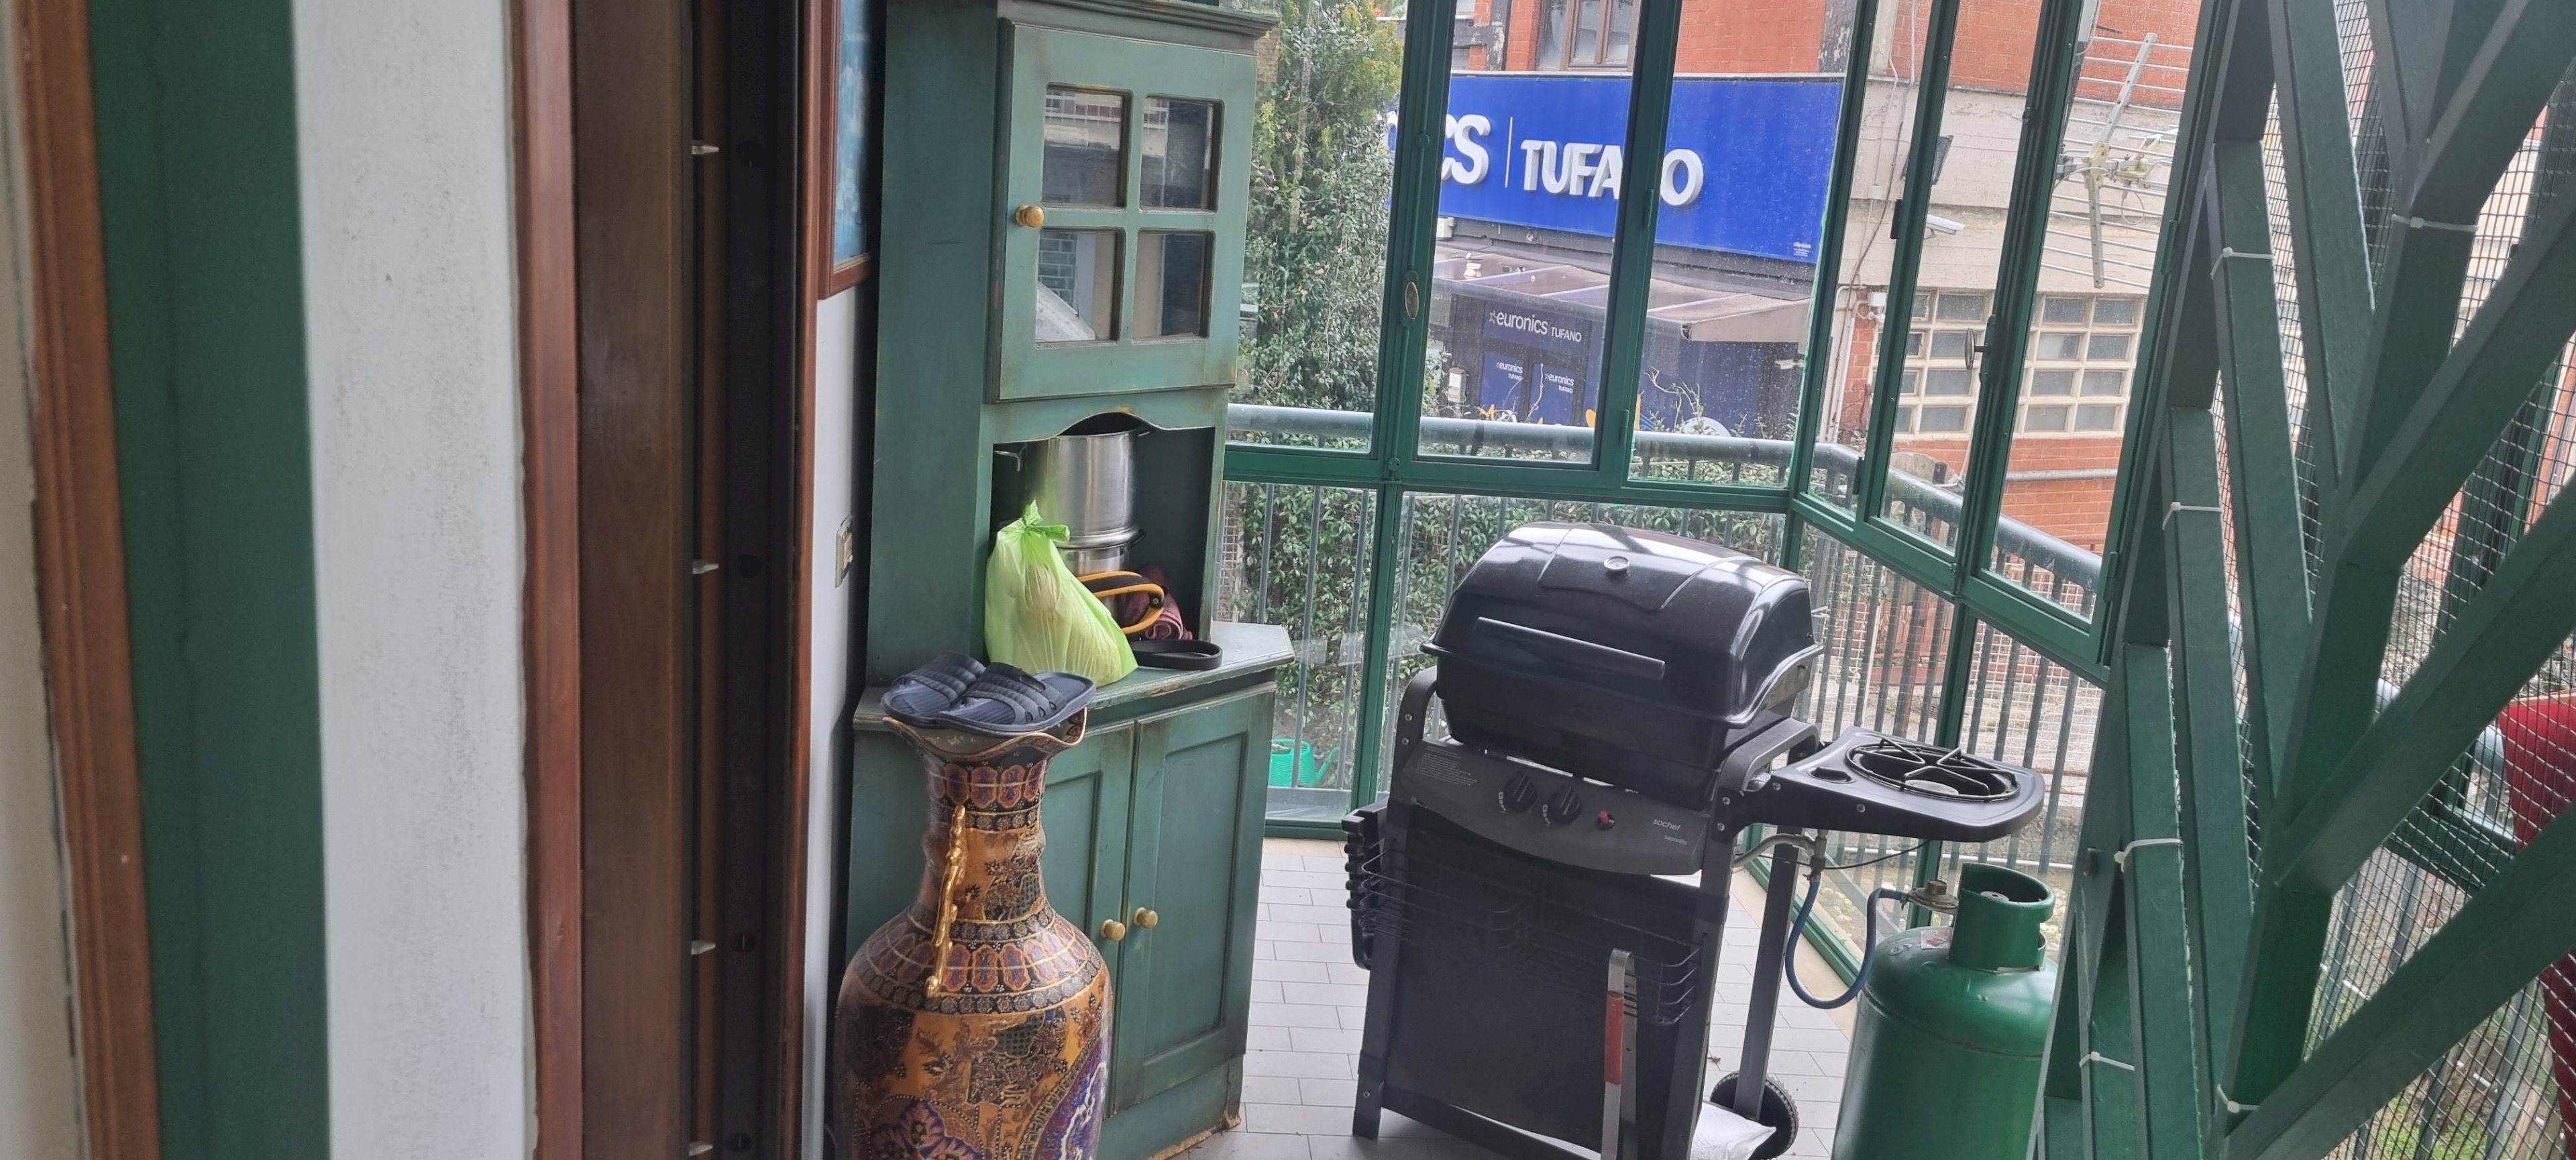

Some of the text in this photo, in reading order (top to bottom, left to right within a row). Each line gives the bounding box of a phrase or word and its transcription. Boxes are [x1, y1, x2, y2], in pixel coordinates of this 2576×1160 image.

[1520, 139, 1704, 206] TUFAO
[1496, 311, 1582, 343] euronics TUFANO
[1499, 362, 1523, 374] euronics
[1548, 373, 1574, 386] euronics
[1653, 819, 1681, 832] sochef
